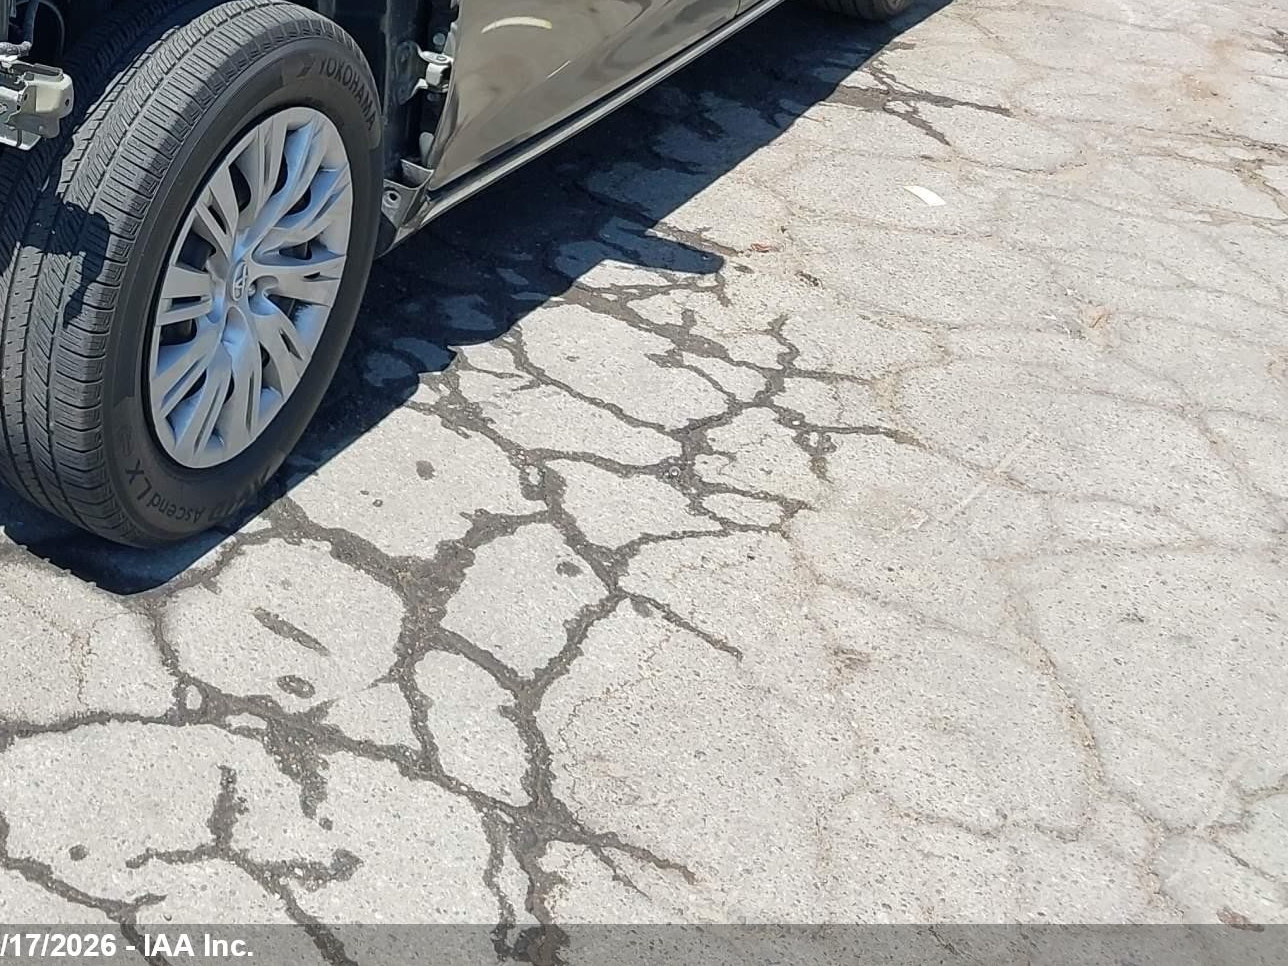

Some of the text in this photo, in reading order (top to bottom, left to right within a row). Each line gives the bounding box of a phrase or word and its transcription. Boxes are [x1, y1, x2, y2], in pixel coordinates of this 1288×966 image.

[319, 58, 377, 131] YOKOHAMA
[124, 458, 152, 501] LX
[147, 492, 205, 524] Ascend
